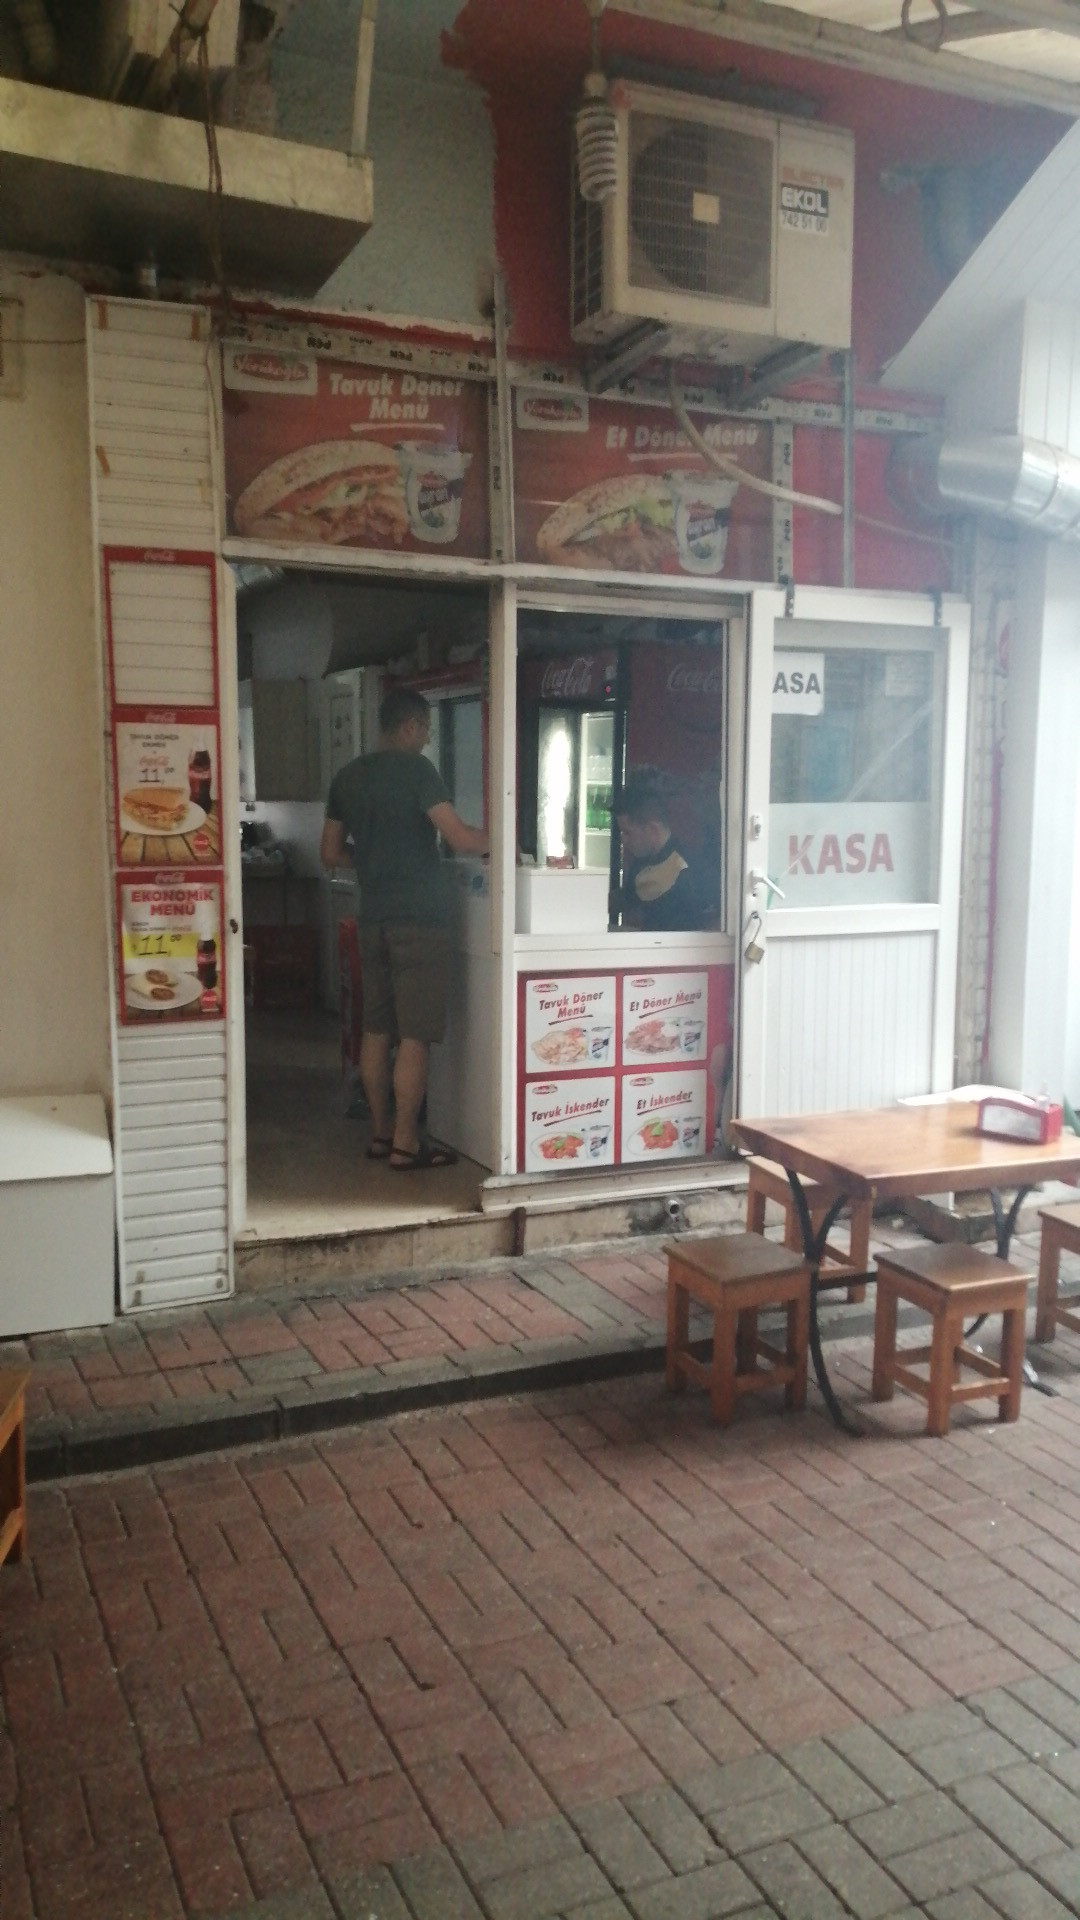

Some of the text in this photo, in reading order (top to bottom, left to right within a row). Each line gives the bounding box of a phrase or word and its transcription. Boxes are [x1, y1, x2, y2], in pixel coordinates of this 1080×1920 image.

[781, 186, 827, 214] EKOL
[329, 373, 395, 398] Tavuk
[400, 375, 465, 399] Döner
[369, 396, 430, 421] Menü
[605, 424, 628, 449] Et
[703, 423, 760, 447] Menü
[773, 671, 821, 696] ASA
[788, 832, 895, 877] KASA
[150, 901, 195, 915] MENÜ
[539, 990, 604, 1011] Tavuk Döner
[557, 1004, 587, 1018] Menü
[629, 989, 703, 1012] Et Döner Menü
[531, 1097, 611, 1122] Tavuk İskender
[636, 1090, 694, 1110] Et İskender
